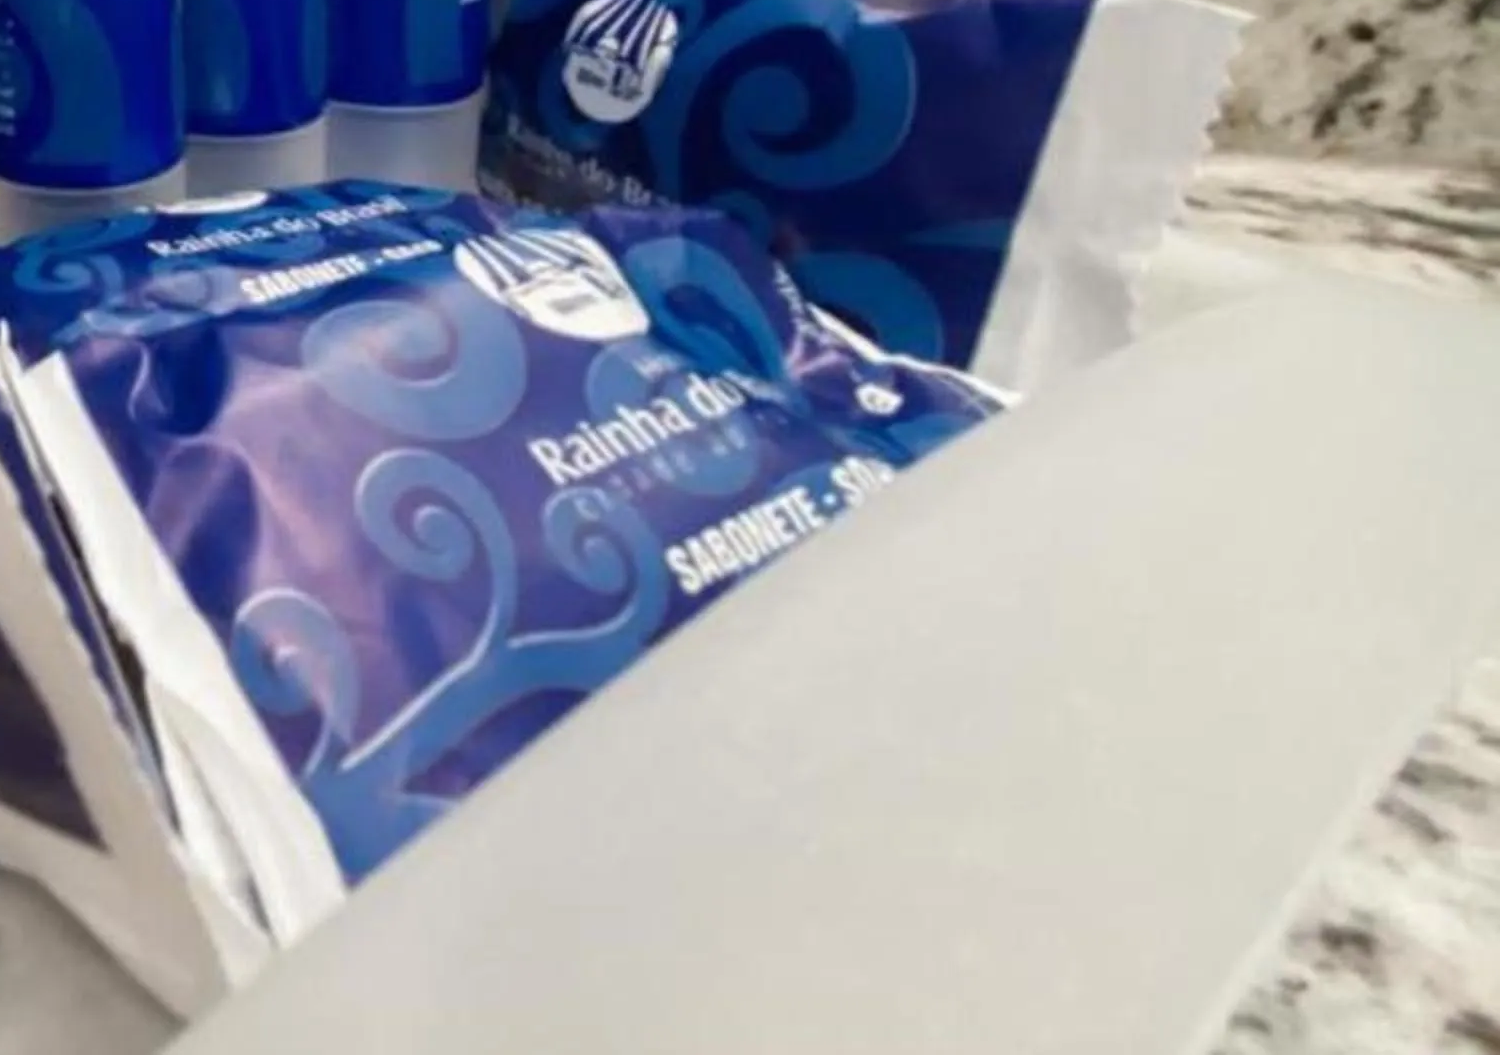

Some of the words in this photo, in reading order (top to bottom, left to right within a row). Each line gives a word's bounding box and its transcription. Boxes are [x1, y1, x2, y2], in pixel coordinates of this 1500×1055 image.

[149, 224, 273, 257] Rainha
[316, 195, 408, 226] Brasil
[240, 253, 369, 306] SABONETE
[528, 397, 698, 487] Rainha
[685, 369, 746, 420] do
[663, 486, 826, 597] SABONETE
